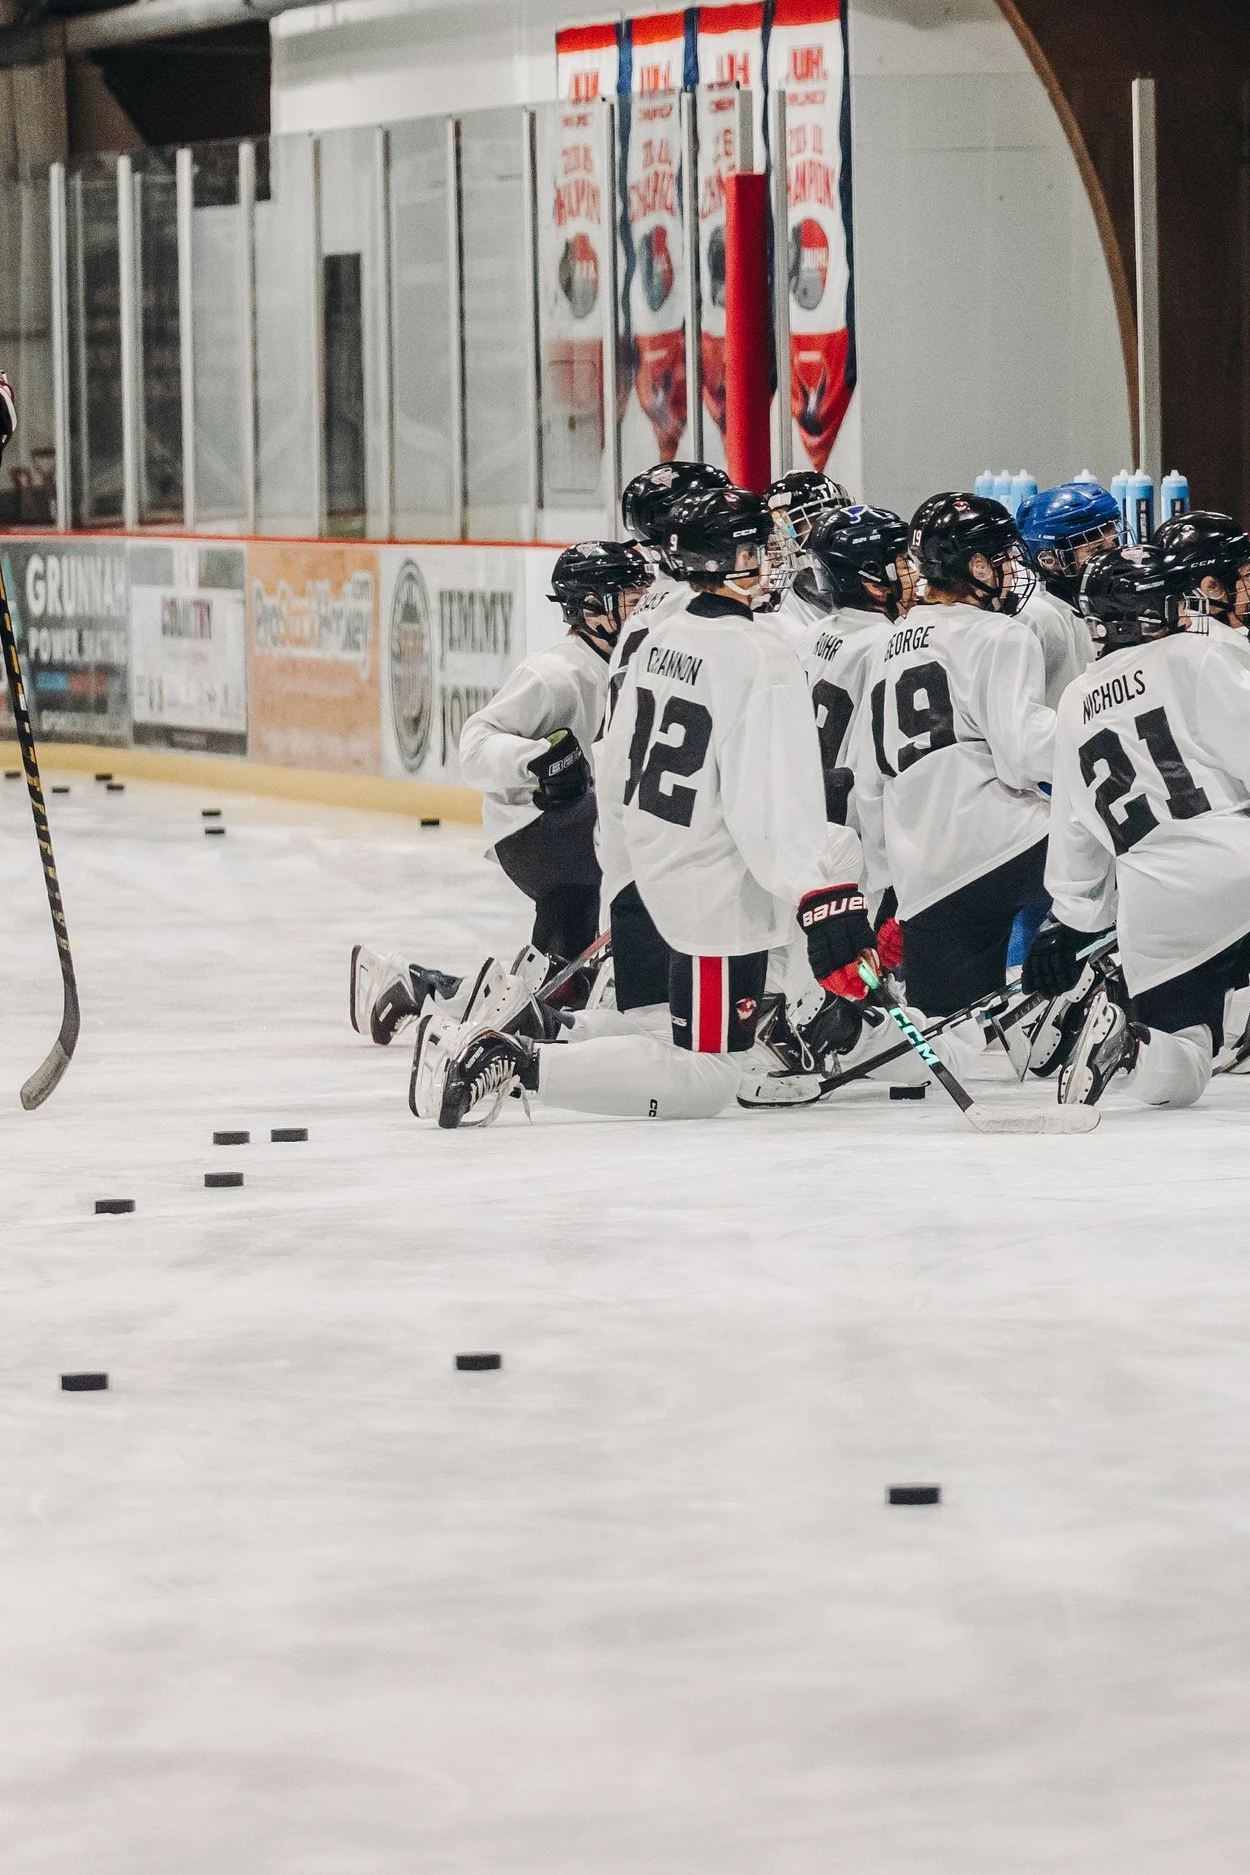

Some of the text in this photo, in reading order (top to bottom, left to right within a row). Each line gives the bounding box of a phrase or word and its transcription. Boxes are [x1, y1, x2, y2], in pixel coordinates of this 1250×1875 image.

[670, 533, 678, 552] 9
[912, 529, 922, 546] 19
[1190, 558, 1216, 569] CCM
[871, 662, 958, 777] 19
[1083, 670, 1145, 725] NICHOLS
[624, 686, 713, 828] 12
[1078, 706, 1212, 857] 21
[889, 1006, 941, 1065] CCM
